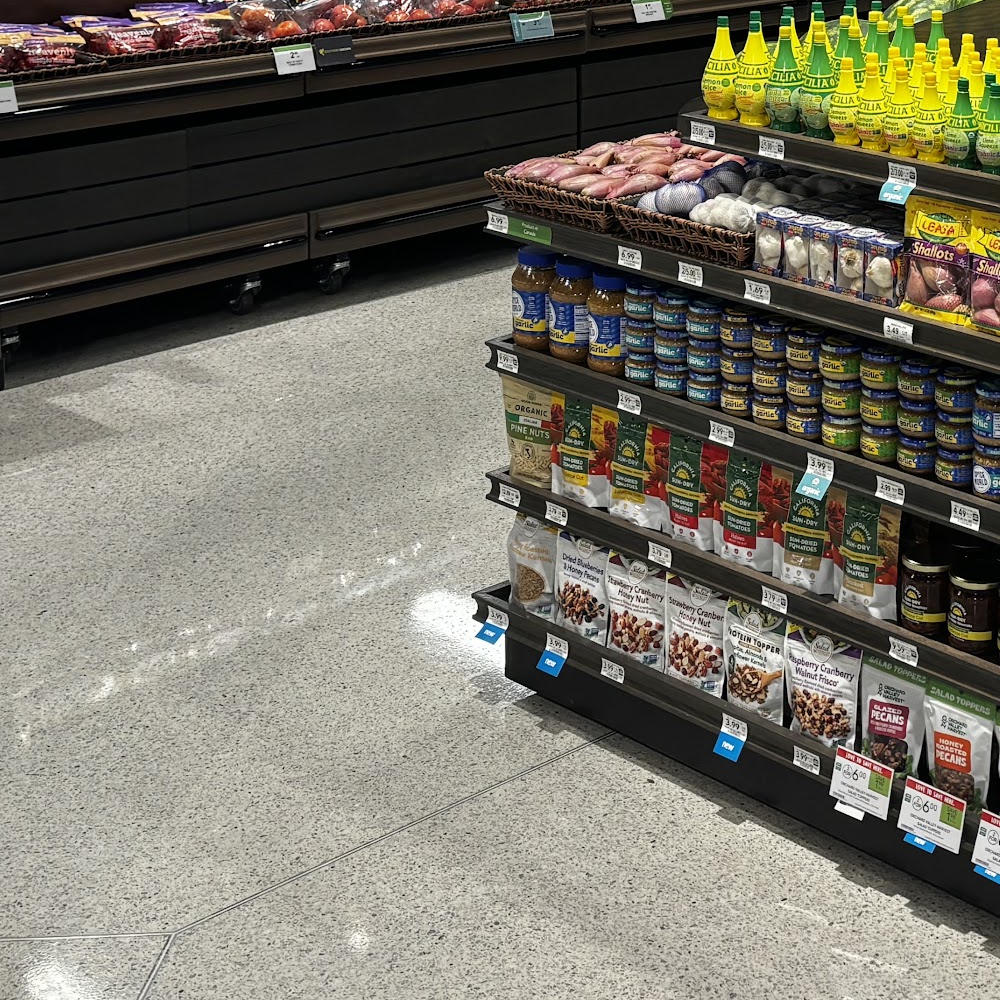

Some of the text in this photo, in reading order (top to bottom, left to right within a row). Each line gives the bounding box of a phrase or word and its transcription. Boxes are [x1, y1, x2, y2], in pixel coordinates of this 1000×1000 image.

[490, 216, 503, 225] 6.99
[521, 222, 533, 230] Product
[621, 252, 635, 261] 6.99
[912, 243, 954, 262] Shallots
[627, 304, 647, 314] garlic
[886, 326, 900, 335] 3.49
[620, 394, 632, 403] 2.99
[514, 405, 548, 417] ORGANIC
[510, 423, 550, 439] PINE NUTS
[711, 426, 724, 435] 2.99
[671, 458, 696, 479] CALIFORNIA
[810, 459, 826, 470] 3.99
[728, 477, 753, 498] CALIFORNIA
[801, 485, 821, 496] organic
[671, 495, 694, 506] SUN-DRIED
[670, 501, 693, 513] TOMATOES
[952, 507, 966, 518] 4.49
[727, 515, 751, 526] SUN-DRIED
[727, 520, 751, 533] TOMATOES
[562, 553, 604, 577] Dried Blueberries
[567, 565, 584, 578] Honey
[584, 570, 600, 584] Pecans
[607, 575, 633, 594] Strawberry
[634, 584, 665, 604] Cranberry
[617, 589, 649, 605] Honey Nut
[549, 639, 562, 648] 3.99
[753, 640, 781, 655] TOPPER
[545, 657, 557, 668] new
[788, 652, 855, 682] Raspberry Cranberry
[795, 666, 818, 681] Walnut
[868, 655, 927, 684] SALAD TOPPERS
[930, 686, 991, 716] SALAD TOPPERS
[873, 704, 903, 716] GLAZED
[725, 718, 740, 730] 3.99
[870, 710, 905, 726] PECANS
[947, 715, 968, 729] ORCHARD
[721, 740, 735, 752] new
[936, 742, 967, 757] ROASTED
[938, 737, 964, 750] HONEY
[935, 751, 967, 768] PECANS
